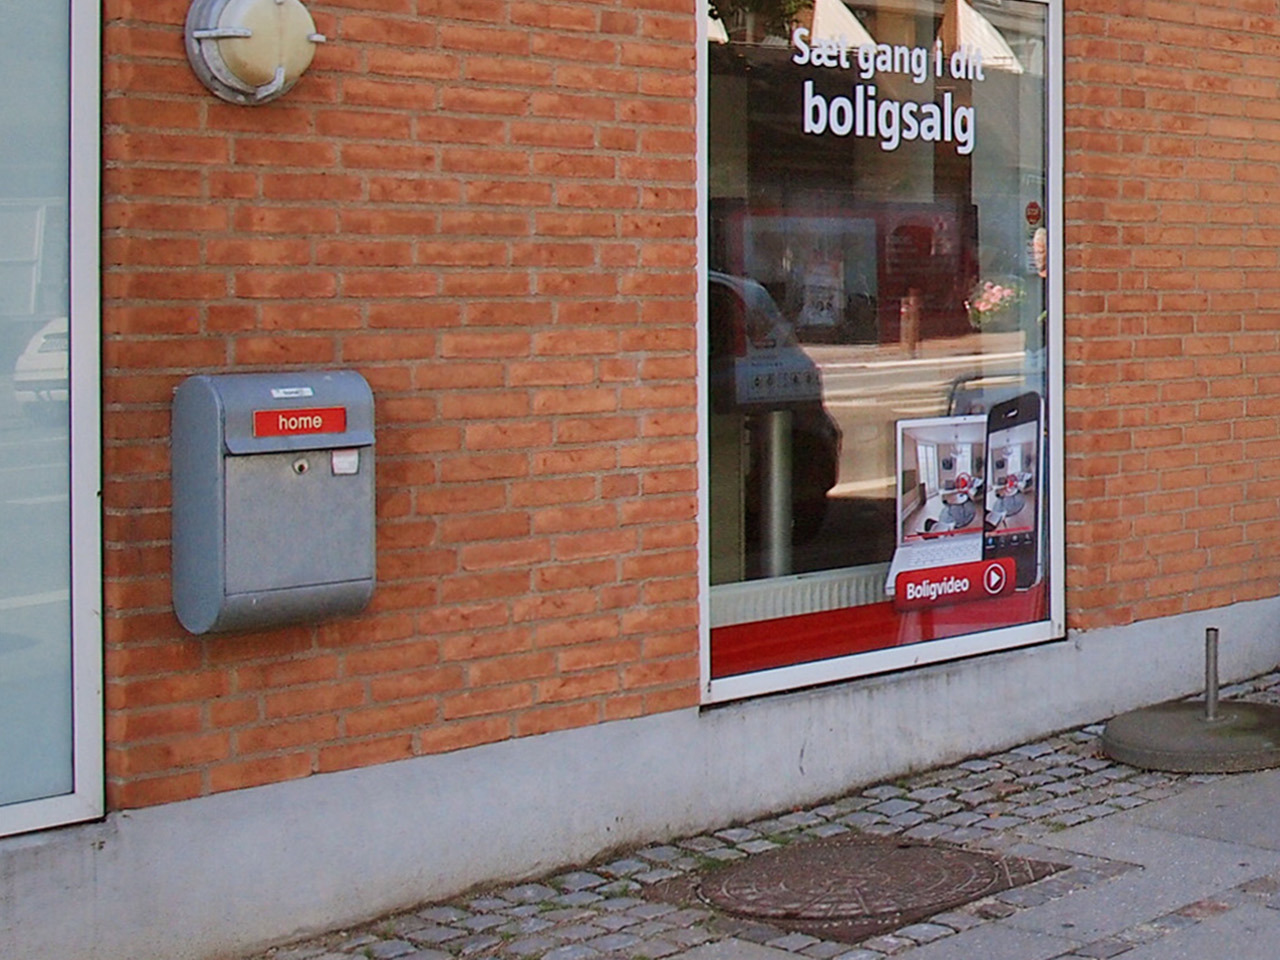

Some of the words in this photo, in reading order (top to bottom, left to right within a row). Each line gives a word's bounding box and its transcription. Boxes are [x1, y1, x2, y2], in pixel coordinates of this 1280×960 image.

[792, 26, 851, 69] Sæt
[858, 42, 928, 84] gang
[935, 36, 943, 78] i
[951, 44, 985, 82] dit
[803, 80, 976, 155] boligsalg
[278, 414, 322, 430] home
[906, 576, 970, 600] Boligvideo
